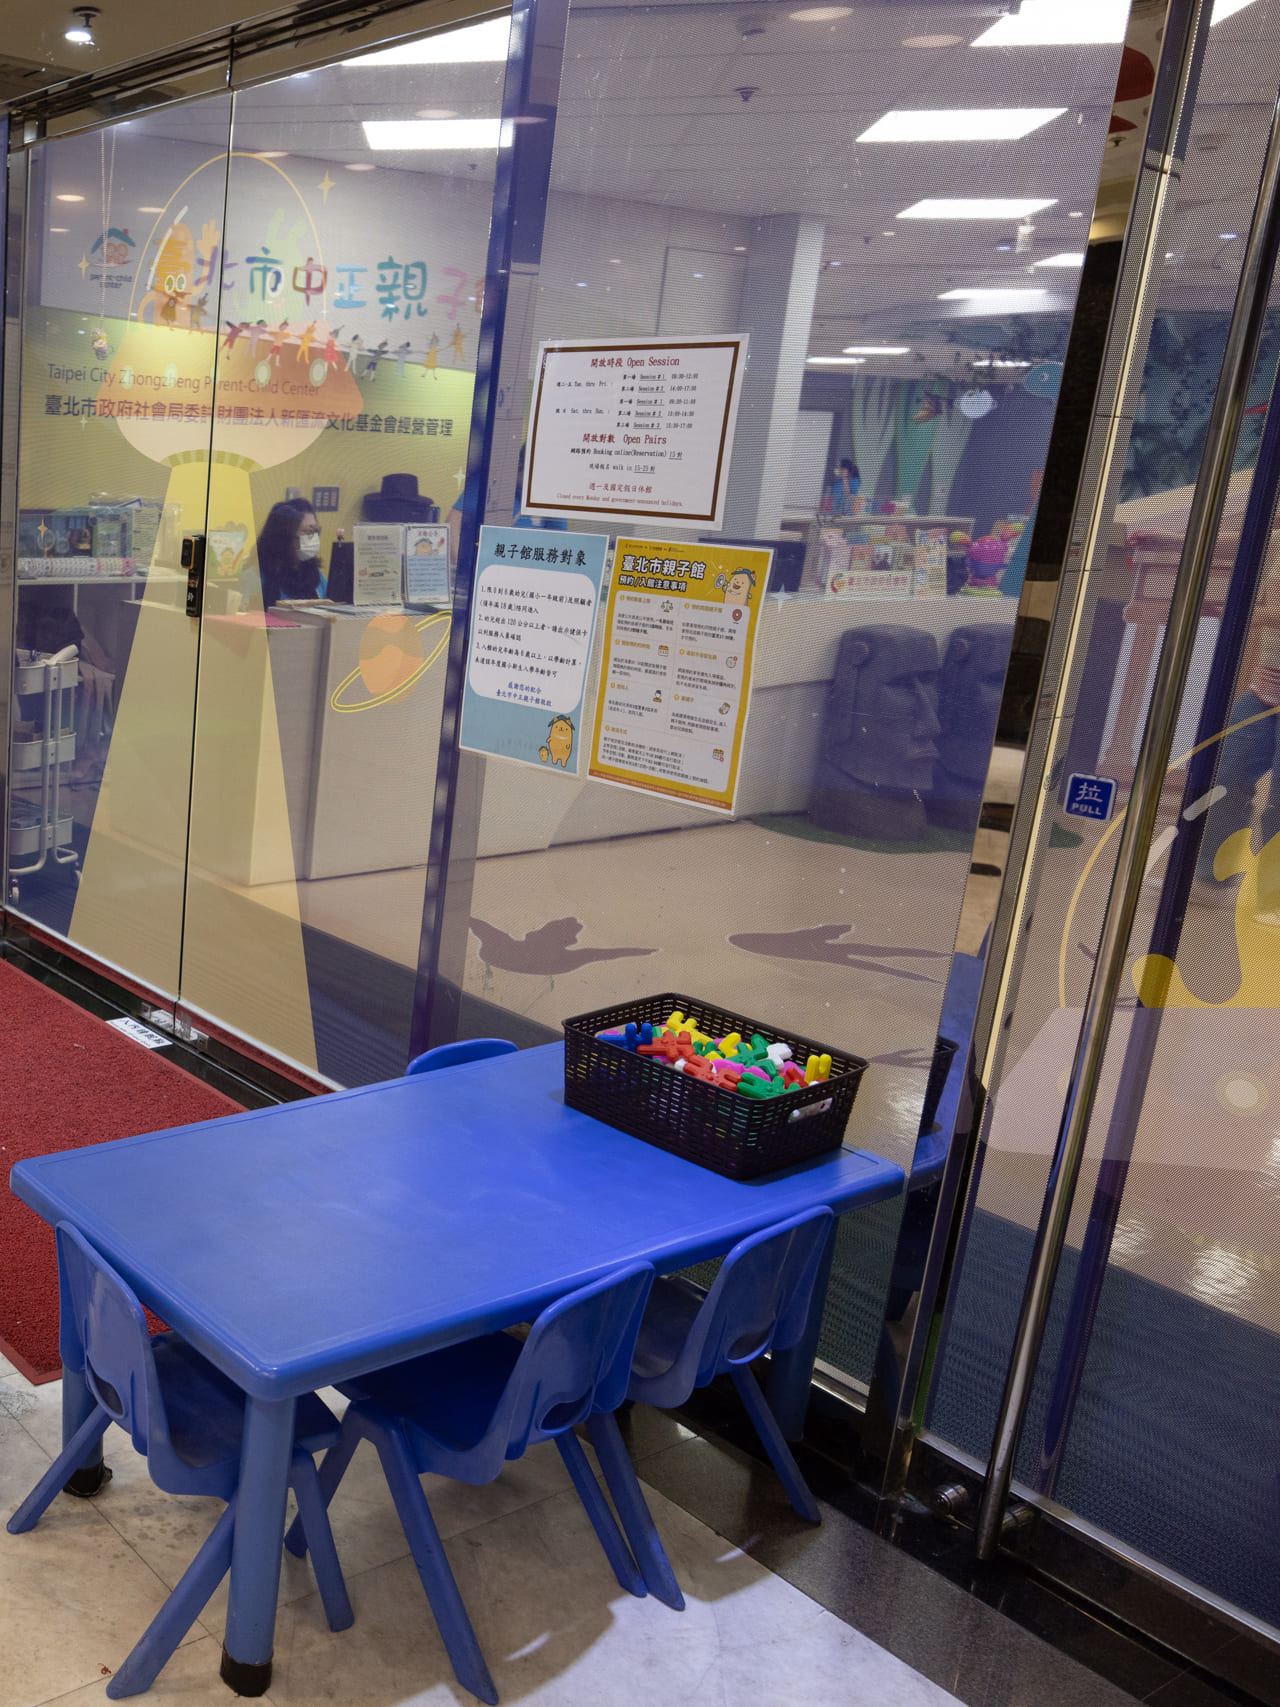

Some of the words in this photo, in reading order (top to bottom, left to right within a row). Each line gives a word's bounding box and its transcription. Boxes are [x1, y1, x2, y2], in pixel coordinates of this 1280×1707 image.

[627, 357, 645, 368] Open
[648, 356, 680, 367] Session
[48, 363, 87, 384] Taipei
[90, 366, 116, 387] City
[119, 370, 201, 393] Zhongzheng
[204, 375, 279, 394] Prent-Child
[281, 380, 322, 397] Center
[623, 434, 641, 444] Open
[644, 434, 667, 445] Pairs
[494, 543, 587, 566] 親子館服務對象
[621, 554, 707, 580] 臺北市親子館
[1075, 782, 1103, 802] 拉
[1071, 802, 1102, 816] PULL
